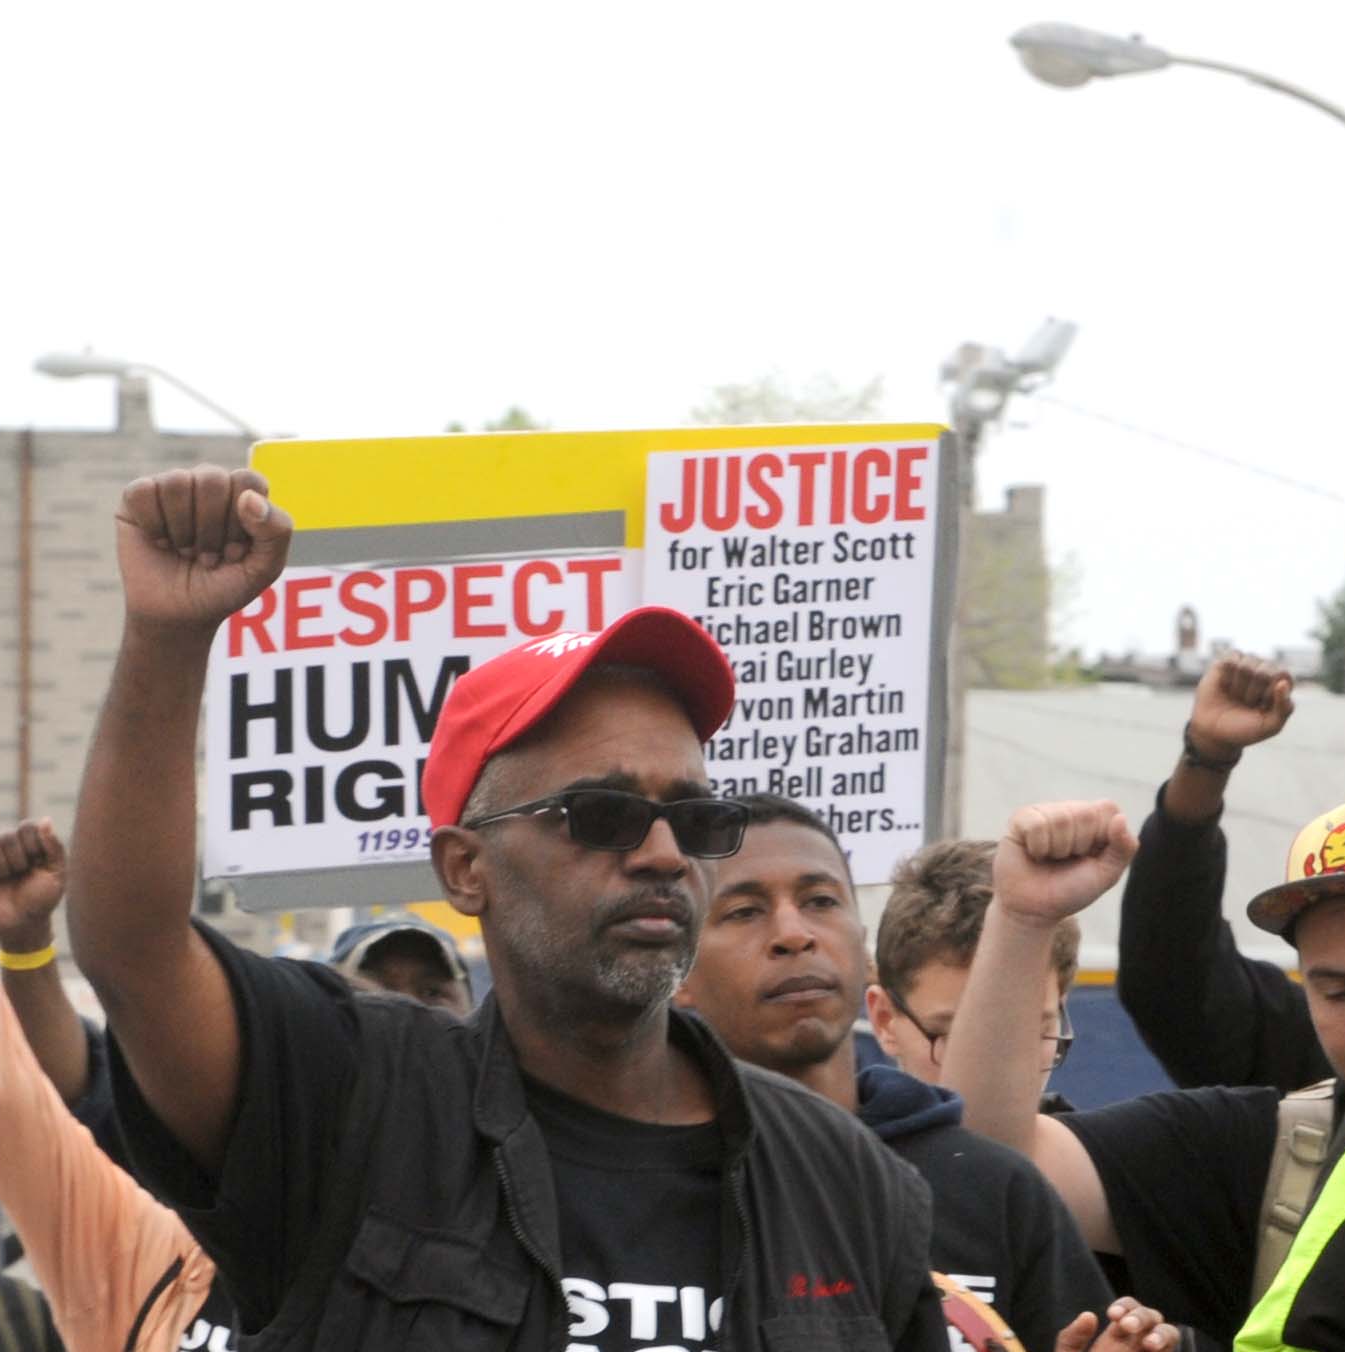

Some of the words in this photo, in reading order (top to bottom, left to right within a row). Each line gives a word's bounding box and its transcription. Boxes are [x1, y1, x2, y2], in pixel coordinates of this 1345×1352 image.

[659, 447, 929, 534] JUSTICE
[668, 539, 712, 571] for
[722, 535, 824, 569] Walter
[833, 531, 915, 564] Scott
[227, 558, 622, 658] RESPECT
[707, 576, 764, 608] Eric
[773, 573, 875, 606] Garner
[694, 611, 798, 647] ichael
[808, 610, 901, 642] Brown
[776, 648, 873, 686] Gurley
[803, 684, 905, 720] Martin
[806, 723, 919, 758] Graham
[768, 767, 823, 799] Bell
[832, 763, 886, 796] and
